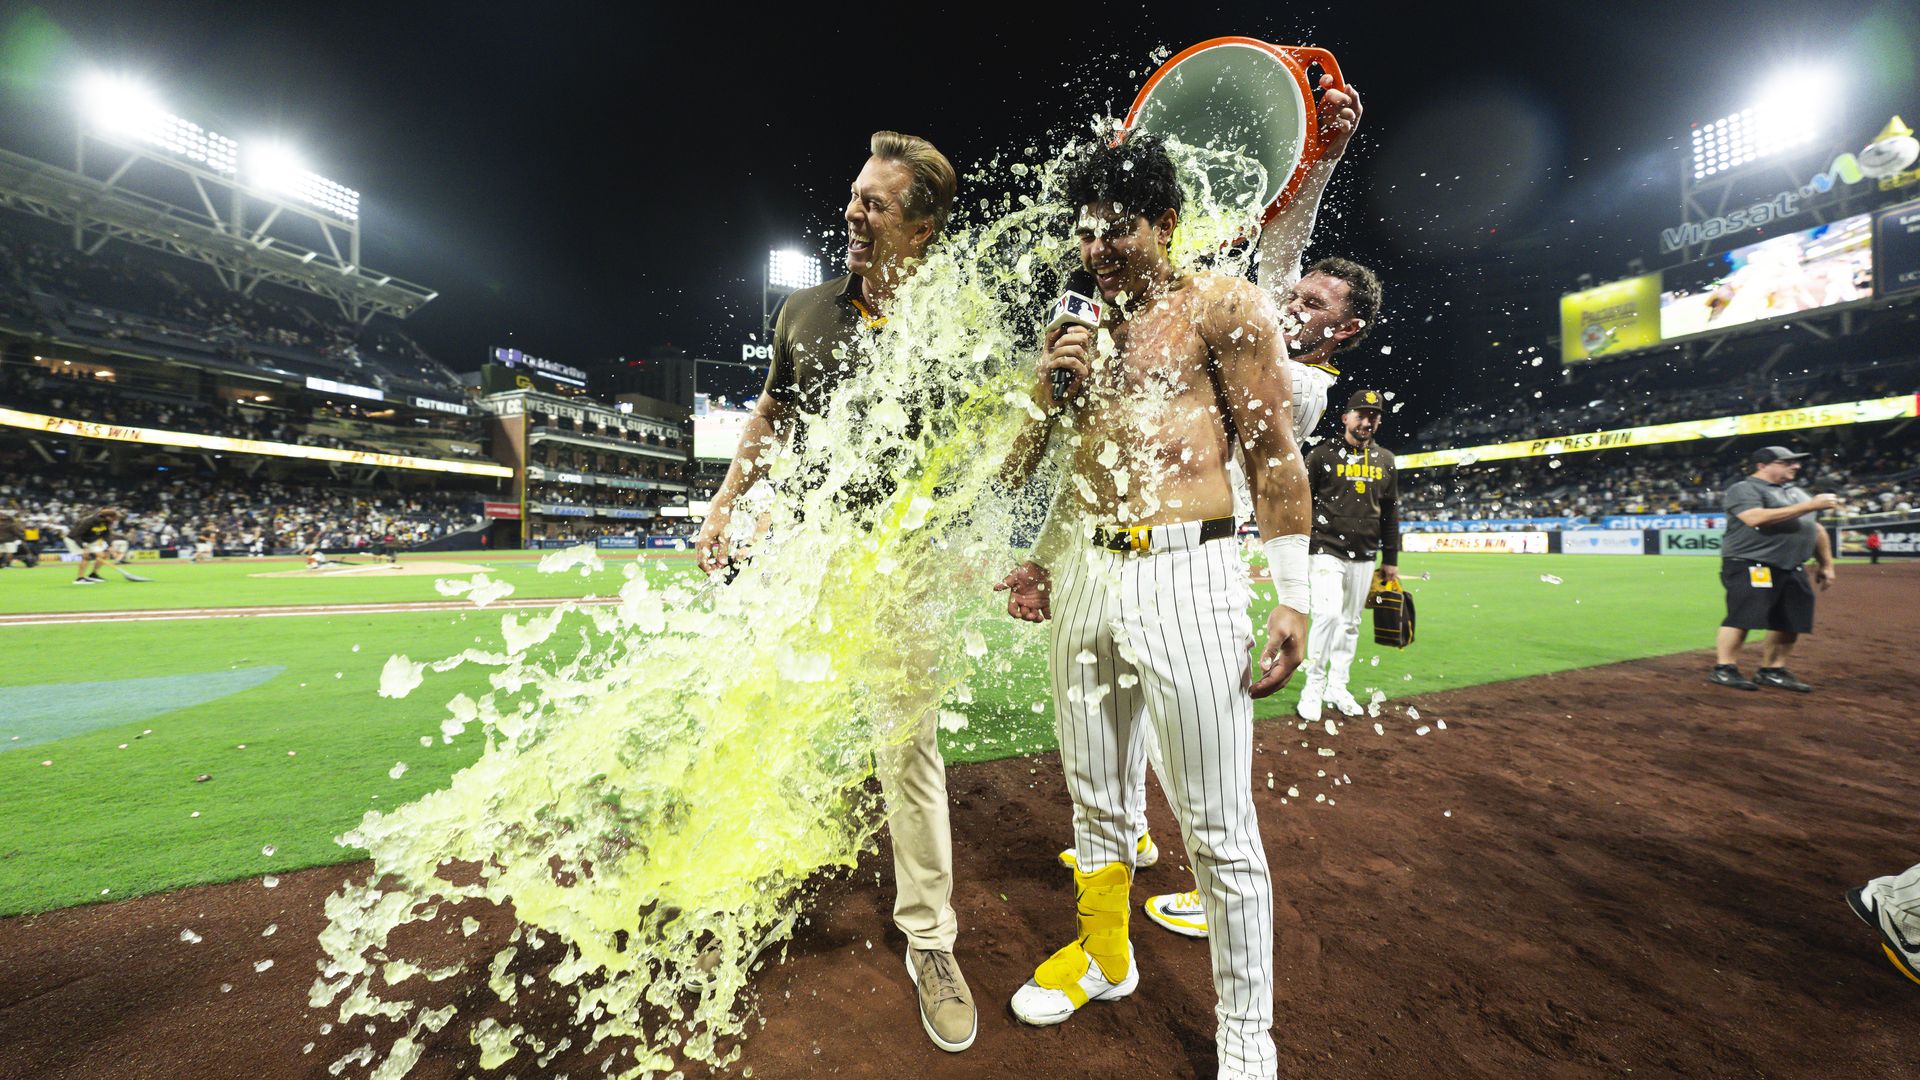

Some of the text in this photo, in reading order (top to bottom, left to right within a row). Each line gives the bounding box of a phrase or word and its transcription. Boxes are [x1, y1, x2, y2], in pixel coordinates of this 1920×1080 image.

[1662, 190, 1799, 253] Viasat
[415, 397, 468, 416] CUTWATER
[525, 399, 584, 421] WESTERN
[588, 411, 623, 431] METAL
[627, 420, 664, 437] SUPPLY
[108, 427, 142, 440] WIN
[1598, 431, 1632, 446] WIN
[1336, 463, 1383, 480] PADRES
[1436, 538, 1507, 548] PADRES WIN
[1667, 534, 1724, 550] Kals
